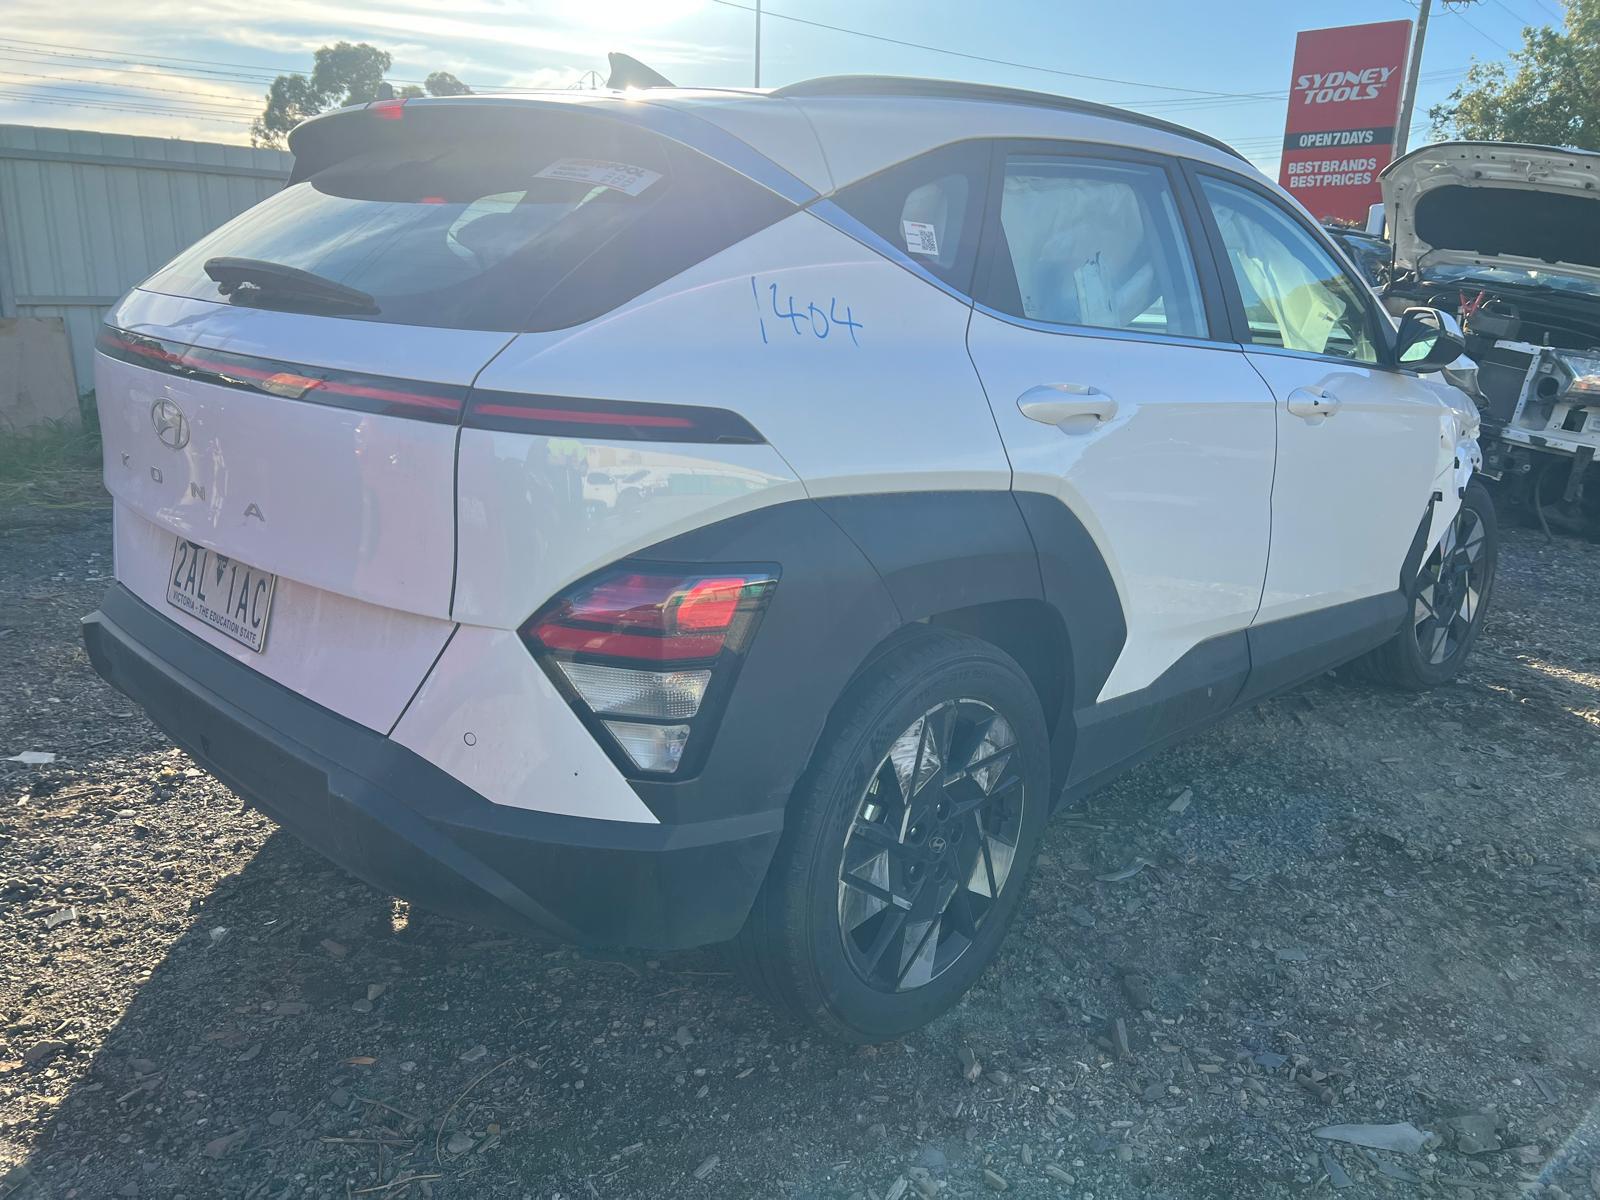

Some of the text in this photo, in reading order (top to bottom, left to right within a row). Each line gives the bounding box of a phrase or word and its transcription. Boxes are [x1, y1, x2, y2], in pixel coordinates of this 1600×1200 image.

[1294, 66, 1397, 90] SYDNEY
[1304, 84, 1382, 105] TOOLS
[751, 276, 863, 348] 1404
[121, 451, 265, 522] KONA
[173, 541, 267, 628] 2AL 1AC
[173, 591, 195, 610] VICTORIA
[199, 604, 209, 618] THE
[209, 607, 239, 634] EDUCATION
[240, 627, 257, 644] STATE
